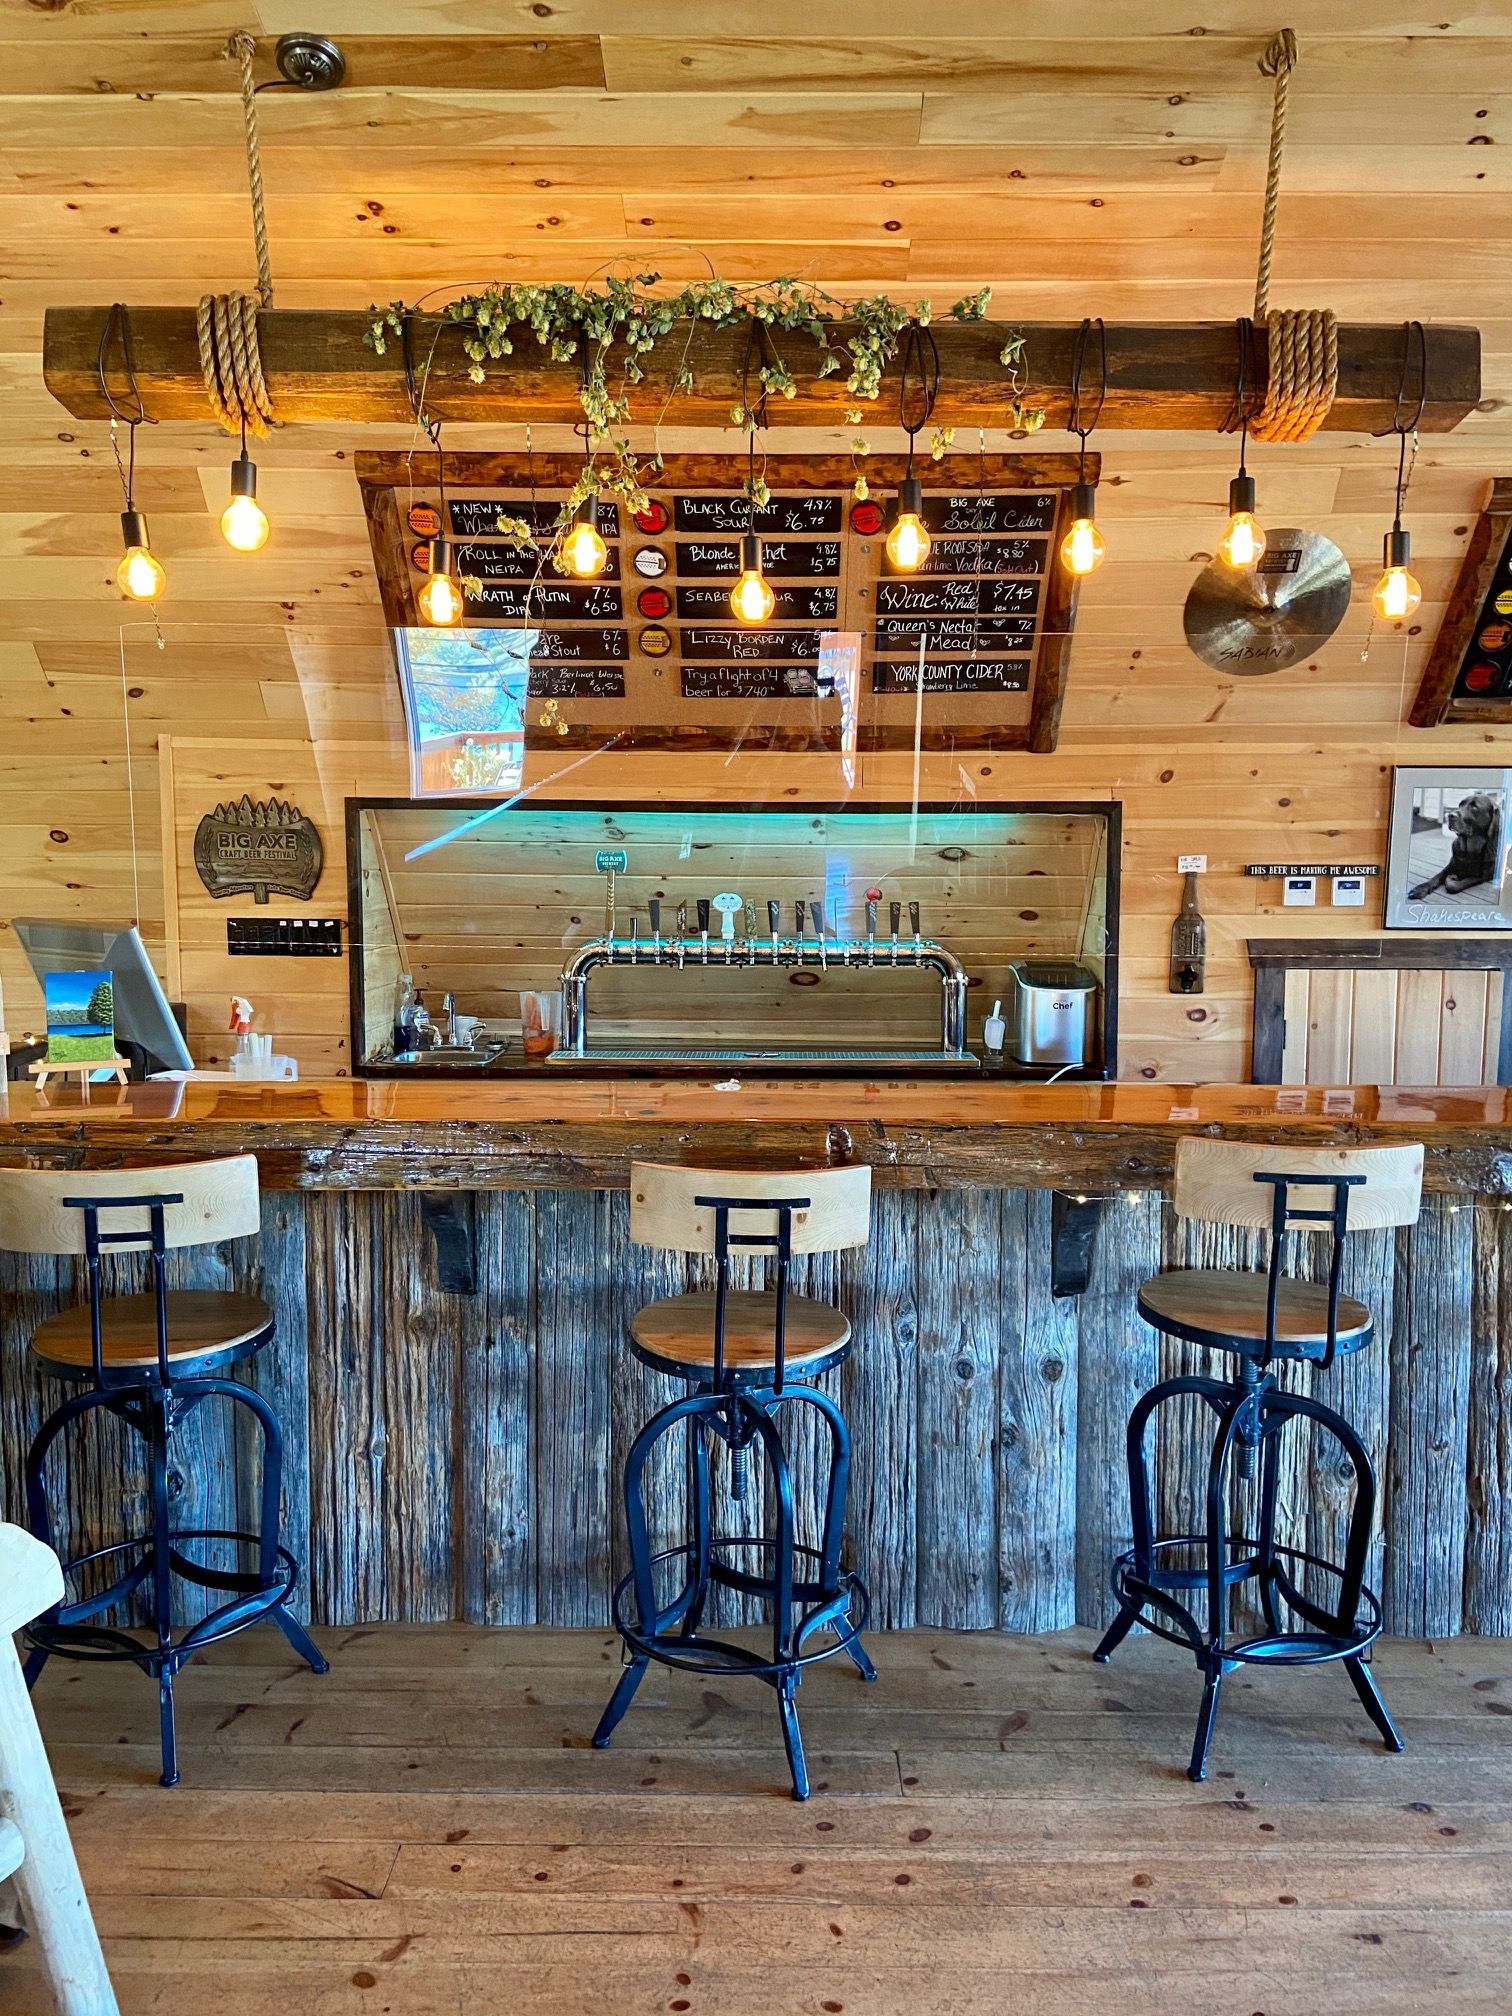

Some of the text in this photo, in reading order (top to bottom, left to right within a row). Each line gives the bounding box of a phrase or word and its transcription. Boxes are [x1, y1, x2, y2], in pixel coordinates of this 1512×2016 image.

[683, 499, 726, 515] BLACK
[803, 499, 832, 511] 4.8%
[949, 497, 1051, 508] BIG AXE 6%
[712, 510, 825, 530] SOUR $6.75
[601, 523, 617, 535] IPA
[1013, 540, 1030, 550] 5%
[507, 551, 515, 559] IN
[520, 550, 535, 559] THE
[541, 550, 556, 560] HA
[689, 545, 736, 561] Blonde
[485, 564, 524, 575] NEIPA
[592, 586, 611, 600] 7%
[942, 582, 974, 596] Red
[993, 580, 1034, 601] $7.45
[940, 596, 978, 610] White
[887, 619, 936, 633] Queen's
[1018, 620, 1033, 631] 7%
[602, 629, 621, 641] 6%
[929, 635, 972, 650] Mead
[551, 644, 581, 657] Stout
[732, 645, 760, 659] RED
[1216, 647, 1282, 664] SABIAN
[684, 667, 778, 688] Try a flight of 4
[890, 664, 918, 682] YORK
[921, 664, 963, 680] COUNTY
[966, 663, 1004, 681] CIDER
[685, 684, 713, 697] beer
[716, 685, 732, 697] for
[218, 832, 297, 850] BIG AXE
[219, 850, 297, 860] CRAFT BEER FESTIVAL
[1251, 866, 1378, 875] THIS BEER IS MAKING ME AWESOME
[1402, 904, 1506, 923] Shakespeare
[1052, 1001, 1074, 1010] Chef
